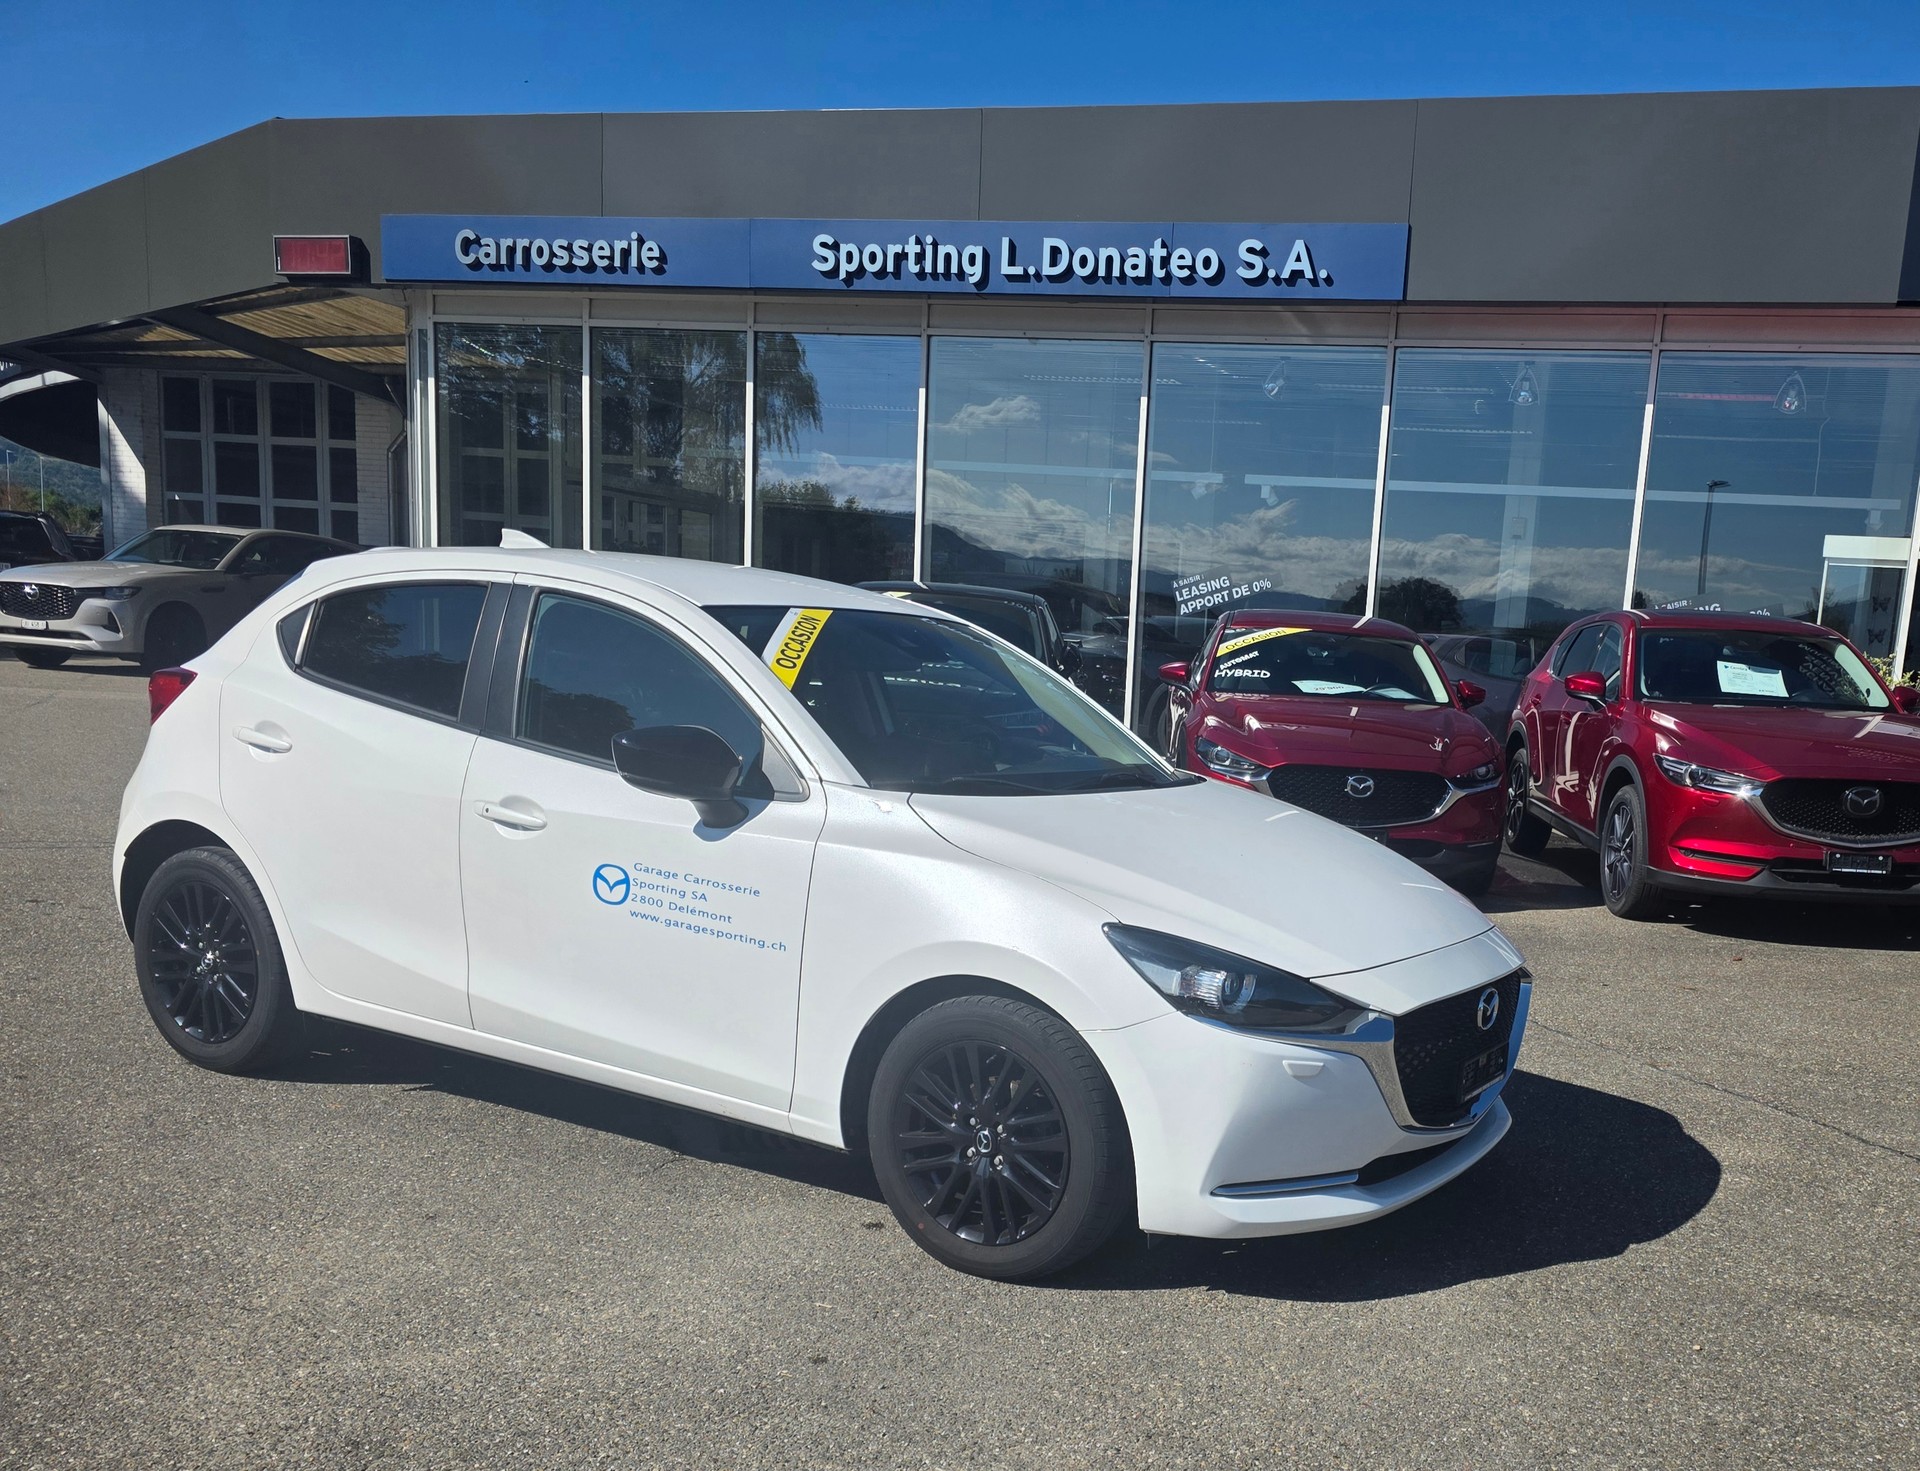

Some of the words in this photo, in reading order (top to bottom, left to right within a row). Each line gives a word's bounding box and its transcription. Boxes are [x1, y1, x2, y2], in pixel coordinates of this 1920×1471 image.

[455, 229, 660, 268] Carrosserie
[811, 234, 983, 283] Sporting
[1001, 236, 1219, 280] L.Donateo
[1236, 239, 1328, 280] S.A.
[1175, 576, 1230, 601] LEASING
[1179, 574, 1201, 586] SAISIR
[1180, 590, 1229, 615] APPORT
[1232, 584, 1250, 599] DE
[1253, 578, 1272, 592] 0%
[775, 614, 821, 669] OCCASION
[1225, 629, 1287, 651] OCCASION
[1214, 669, 1271, 679] HYBRID
[632, 877, 686, 899] Sporting
[691, 891, 708, 902] SA
[633, 862, 679, 879] Garage
[684, 873, 761, 897] Carrosserie
[631, 893, 664, 908] 2800
[668, 901, 732, 924] Delémont
[629, 909, 787, 952] www.garagesporting.ch
